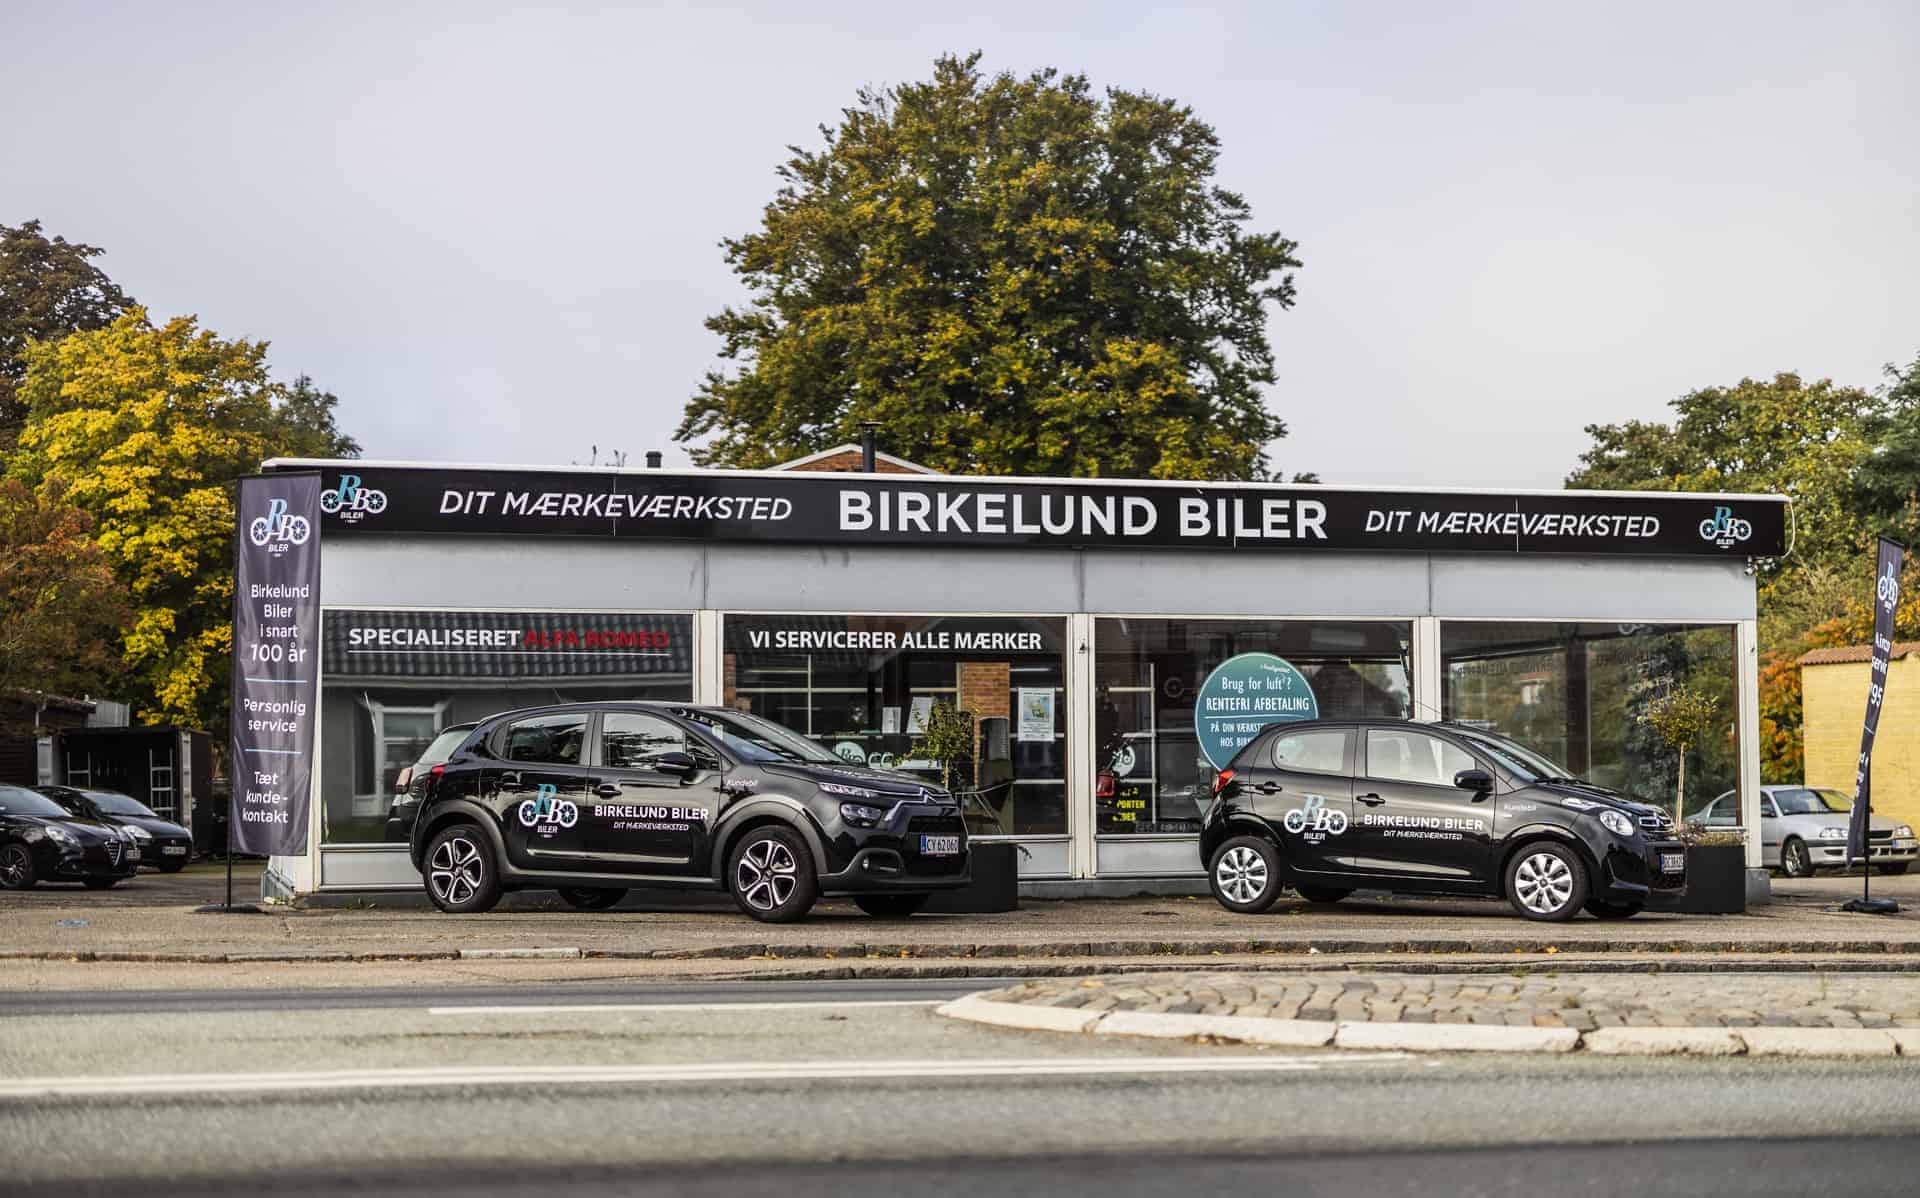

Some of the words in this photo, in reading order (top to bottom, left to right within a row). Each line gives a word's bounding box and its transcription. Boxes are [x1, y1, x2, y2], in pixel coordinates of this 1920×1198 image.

[439, 490, 496, 514] DIT
[501, 491, 793, 521] MÆRKEVÆRKSTED
[838, 489, 1158, 536] BIRKELUND
[1179, 496, 1328, 540] BILER
[1364, 510, 1411, 533] DIT
[1416, 511, 1660, 538] MÆRKEVÆRKSTED
[268, 543, 289, 552] BILER
[250, 583, 309, 599] Birkelund
[263, 604, 293, 618] Biler
[266, 625, 298, 638] snart
[349, 628, 520, 647] SPECIALISERET
[523, 630, 580, 648] ALFA
[586, 631, 669, 649] ROMEO
[749, 631, 770, 648] VI
[775, 631, 897, 648] SERVICERER
[900, 631, 949, 649] ALLE
[954, 632, 1042, 650] MÆRKER
[250, 644, 283, 662] 100
[287, 641, 307, 663] år
[1222, 676, 1244, 694] Brug
[1248, 676, 1262, 690] for
[1266, 676, 1283, 690] luft
[243, 698, 306, 717] Personlig
[1206, 697, 1250, 711] RENTEFRI
[1254, 697, 1310, 711] AFBETALING
[248, 717, 297, 732] service
[1210, 721, 1220, 733] PÅ
[1222, 723, 1235, 733] DIN
[1220, 737, 1234, 747] HOS
[254, 771, 278, 785] Tæt
[242, 808, 289, 824] kontakt
[594, 804, 668, 819] BIRKELUND
[671, 806, 709, 820] BILER
[613, 821, 625, 830] DIT
[1364, 813, 1440, 829] BIRKELUND
[1444, 816, 1484, 831] BILER
